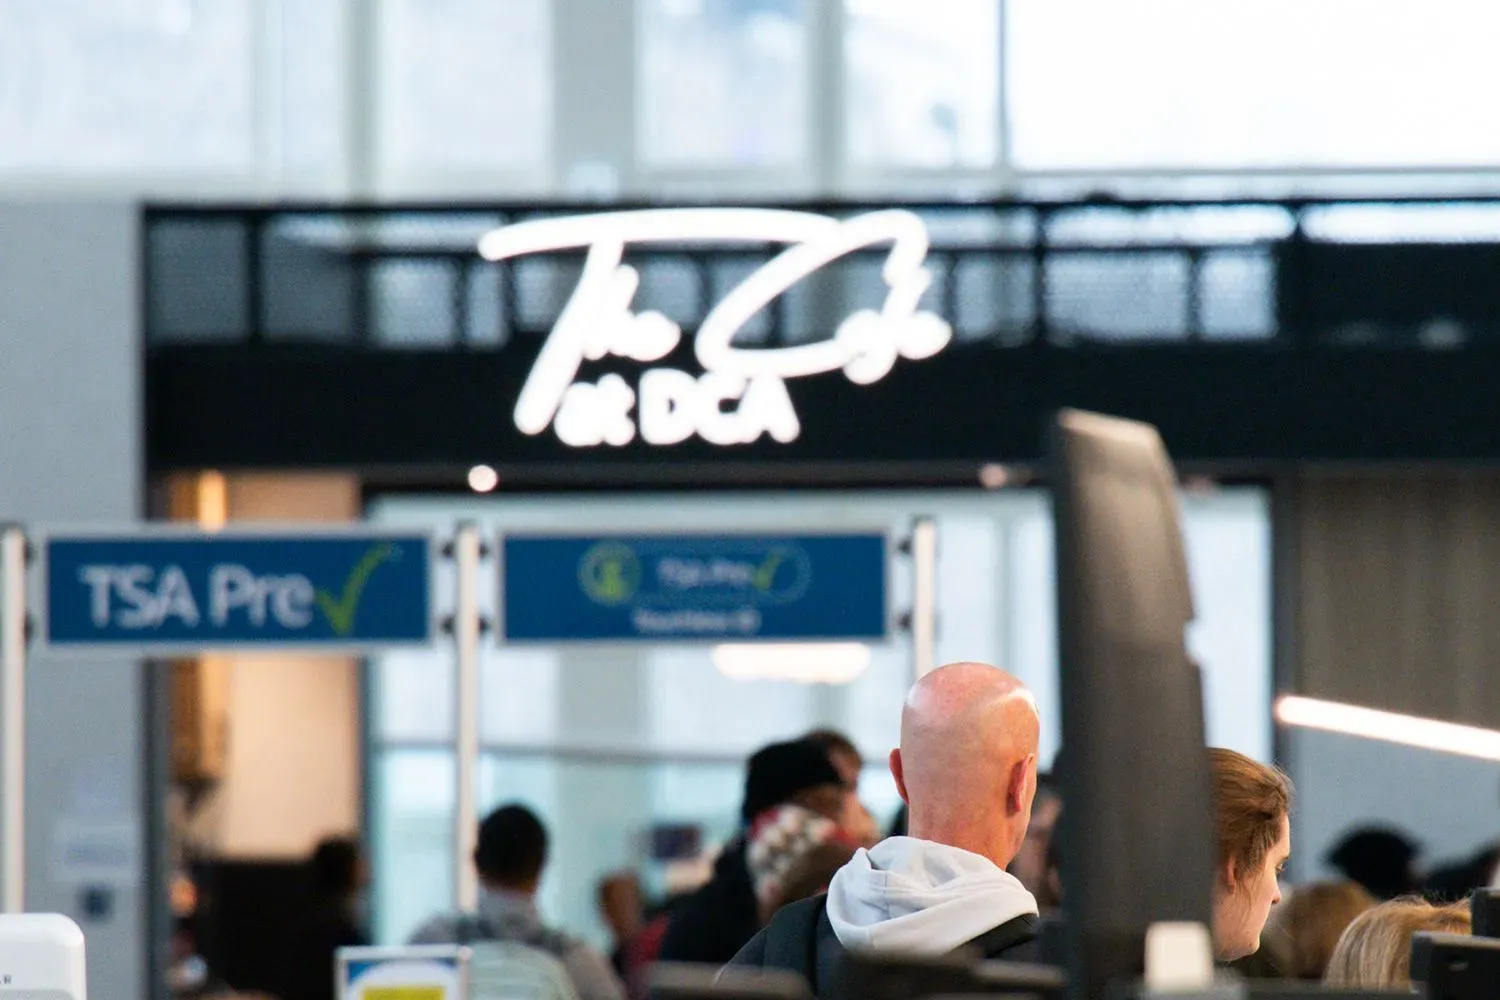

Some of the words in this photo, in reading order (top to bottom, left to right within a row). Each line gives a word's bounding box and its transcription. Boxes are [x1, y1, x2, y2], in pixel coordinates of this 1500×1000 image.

[638, 368, 801, 445] DCA
[78, 563, 200, 629] TSA
[208, 563, 316, 629] Pre
